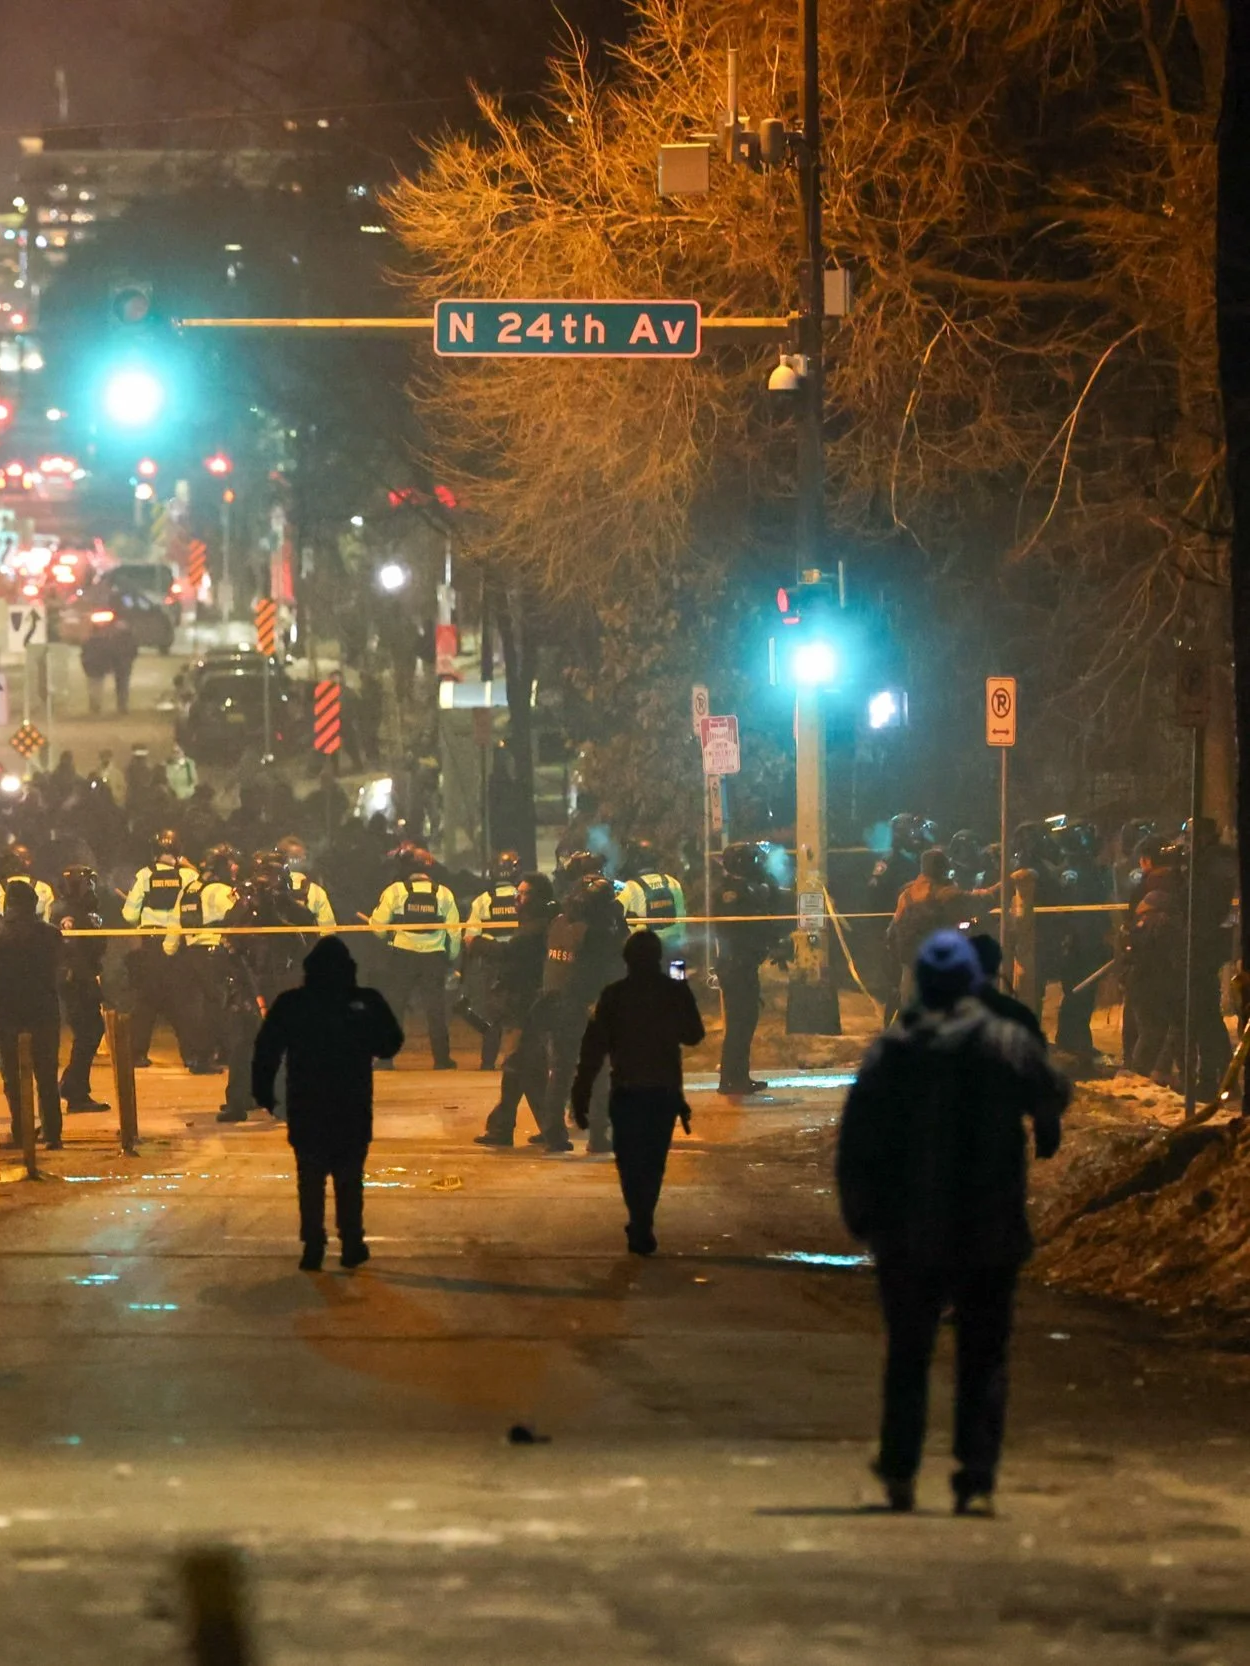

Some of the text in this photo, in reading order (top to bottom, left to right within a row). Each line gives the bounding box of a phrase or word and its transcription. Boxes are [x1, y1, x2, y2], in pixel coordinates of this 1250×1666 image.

[450, 312, 685, 345] N 24th Av
[549, 949, 573, 961] PRESS
